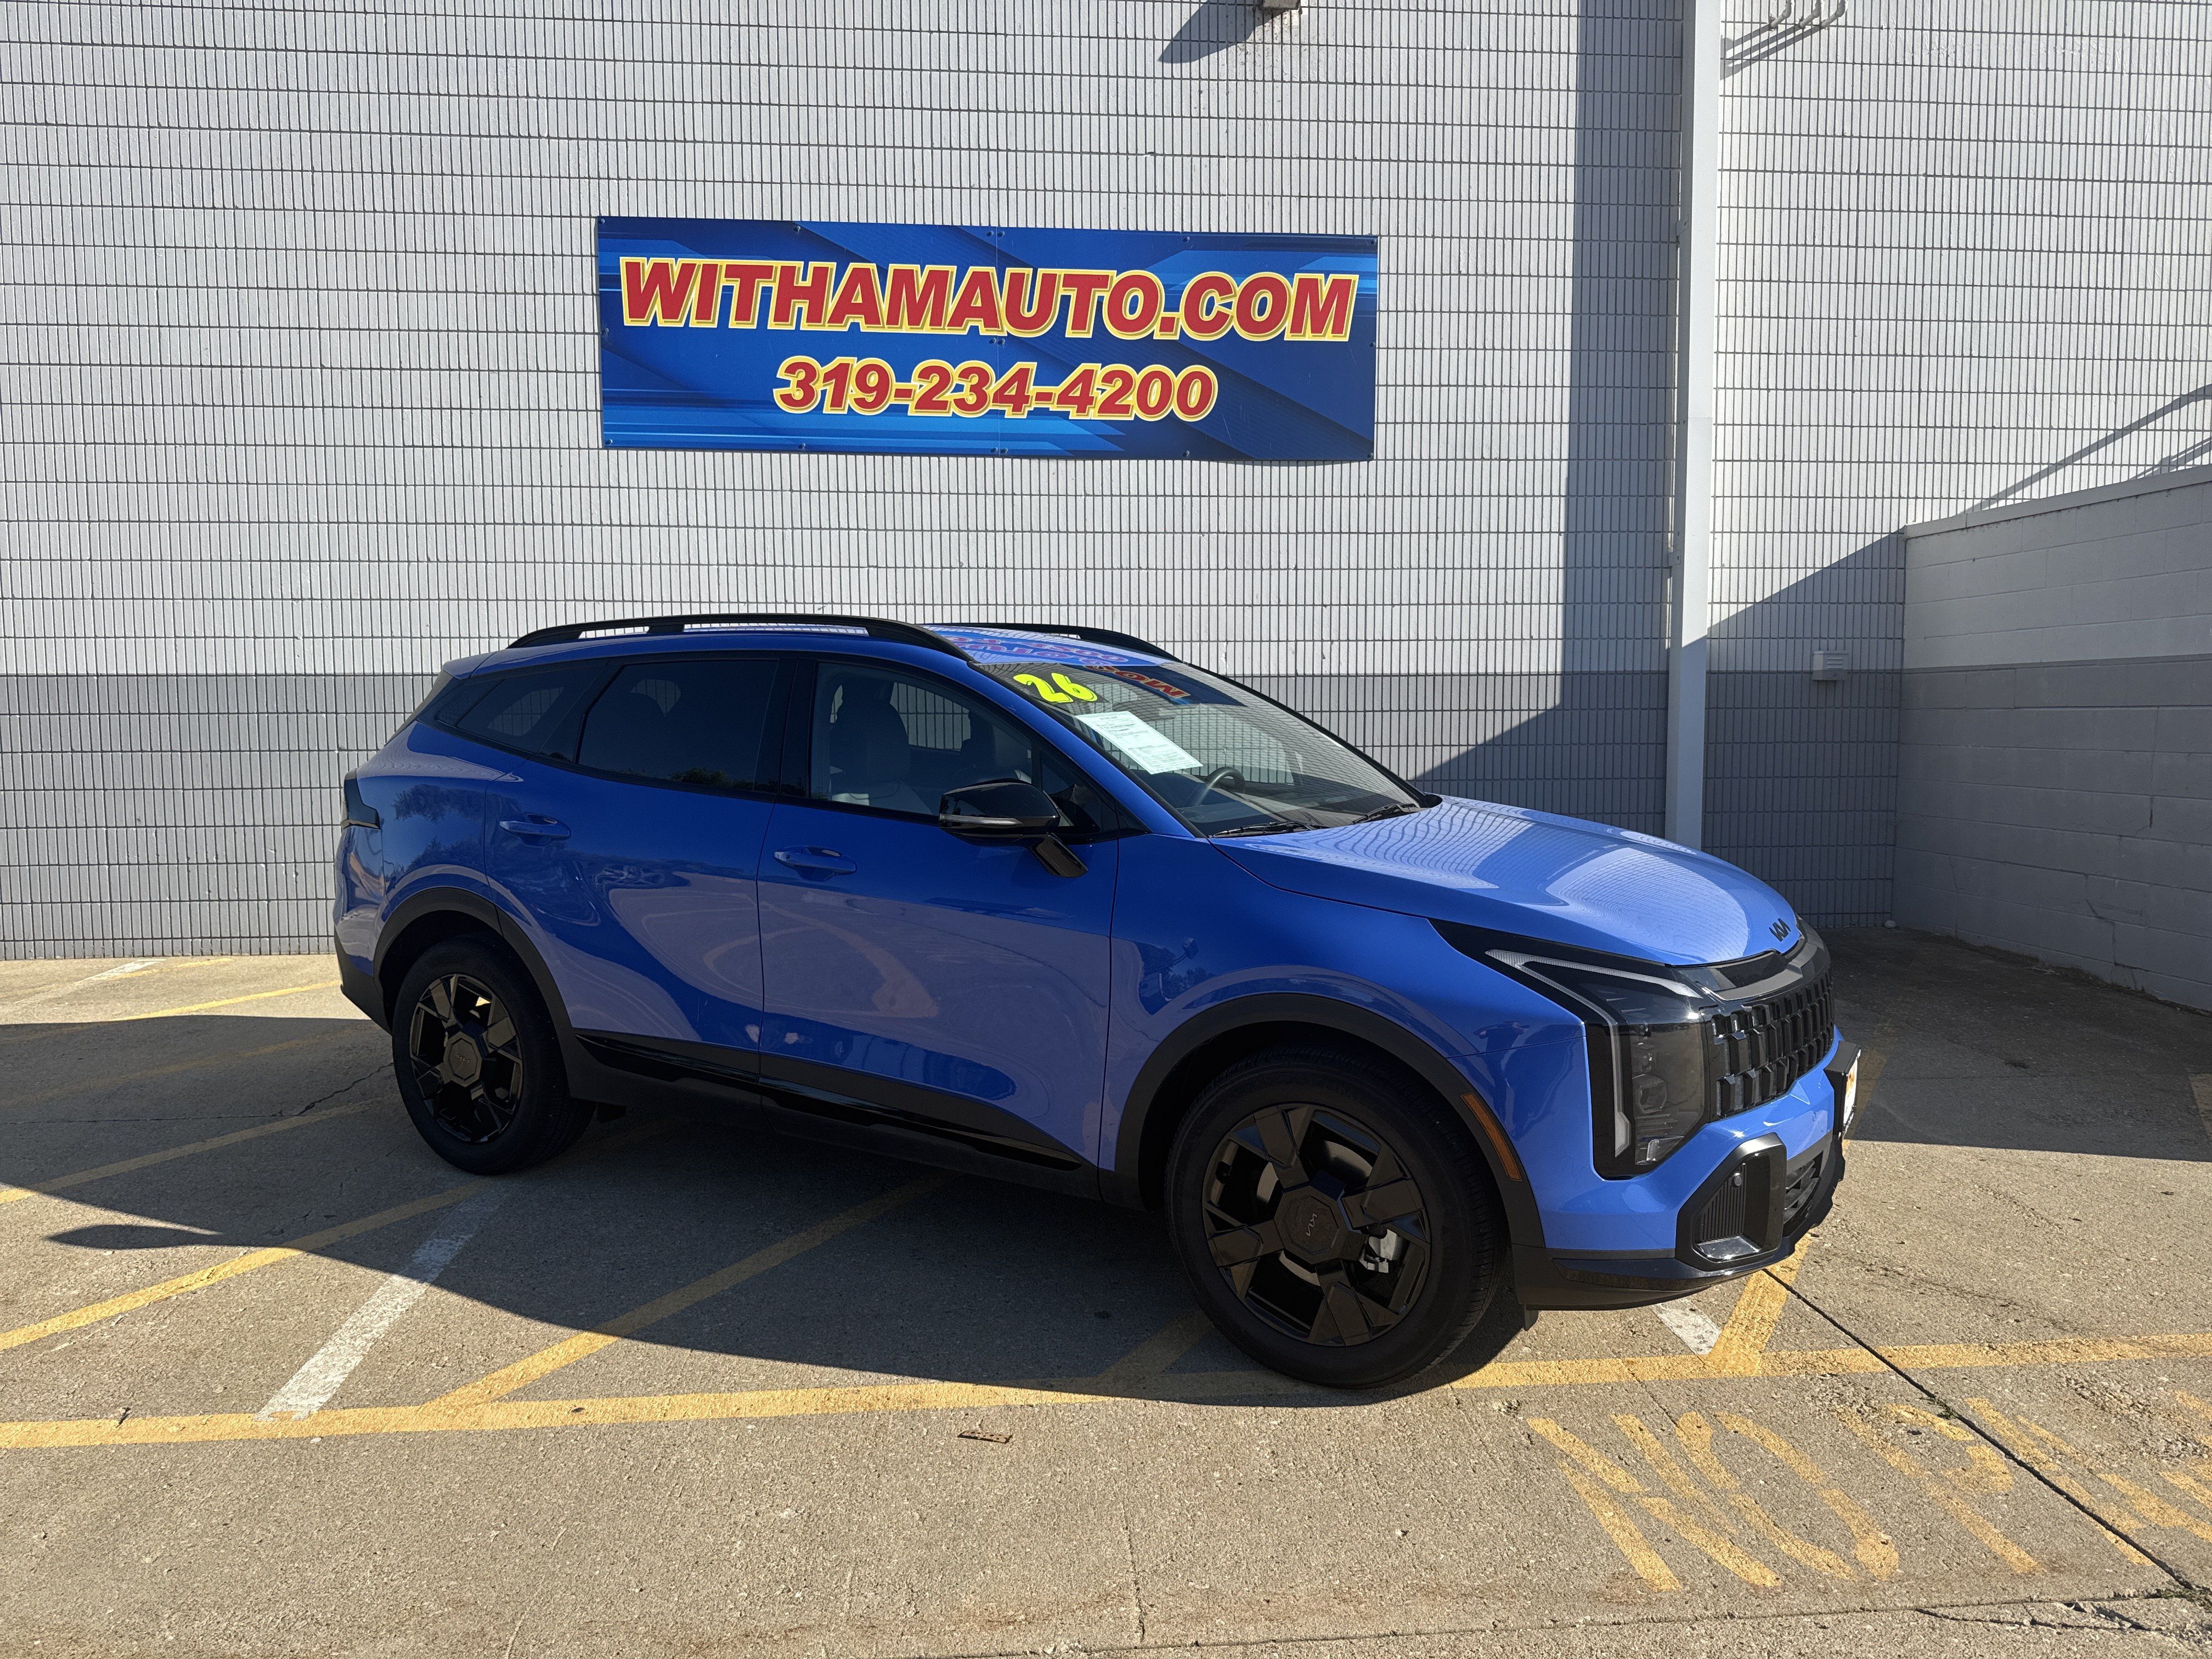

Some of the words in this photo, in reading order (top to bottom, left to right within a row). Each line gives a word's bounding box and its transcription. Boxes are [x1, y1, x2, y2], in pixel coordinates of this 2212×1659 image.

[619, 256, 1358, 342] WITHAMAUTO.COM
[773, 356, 1218, 422] 319-234-4200
[1013, 673, 1097, 703] 26
[1527, 1410, 1899, 1592] NO
